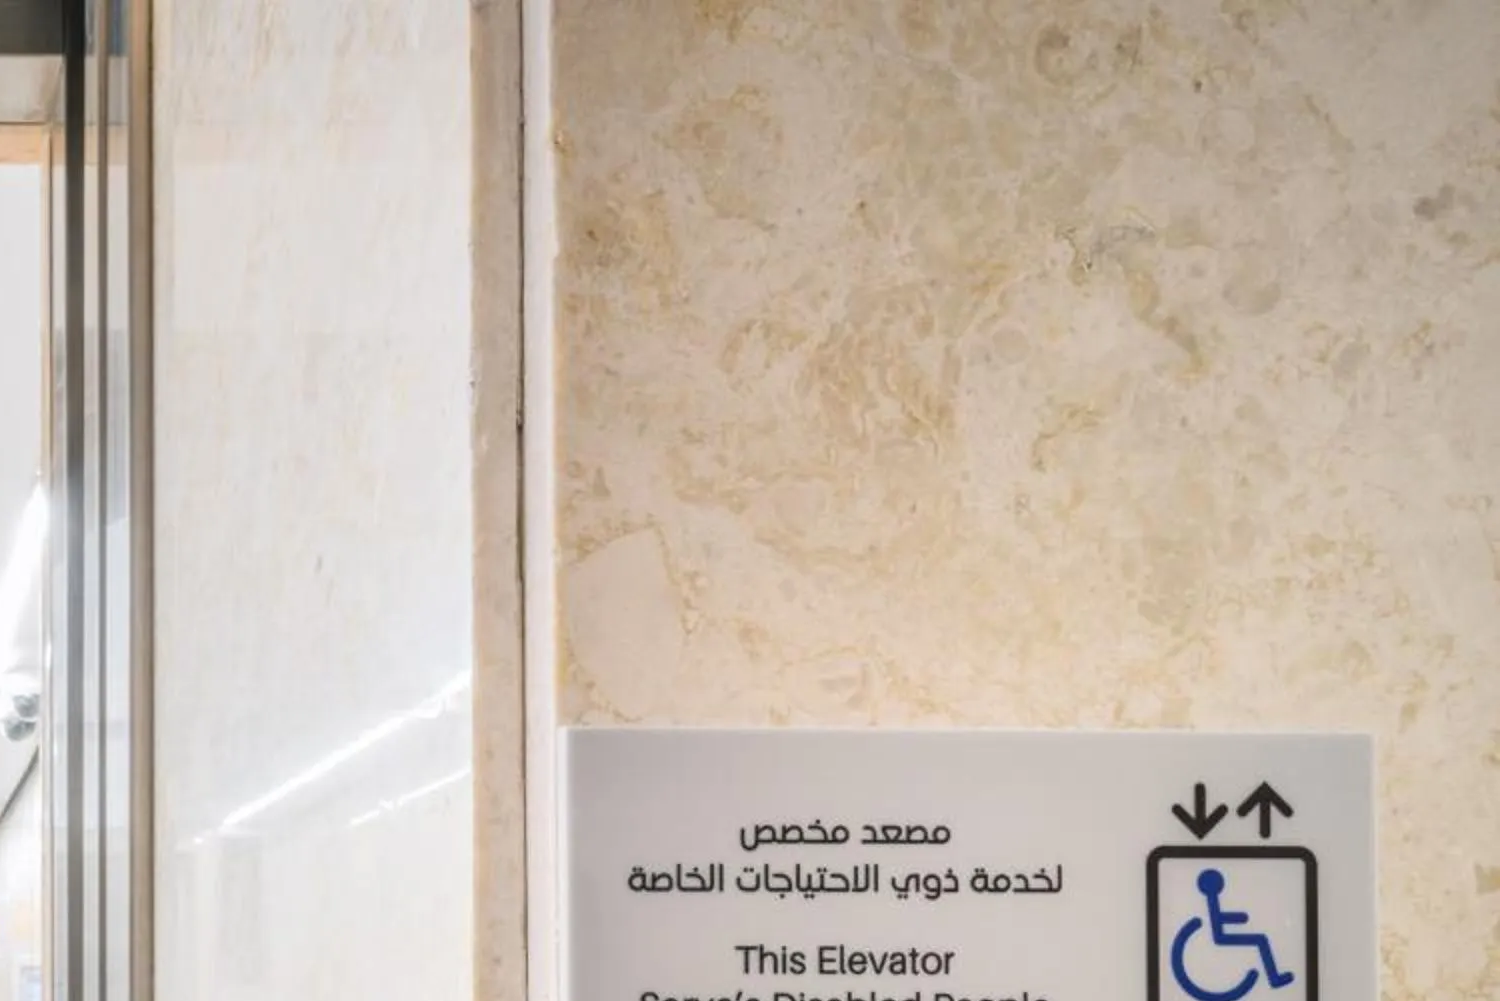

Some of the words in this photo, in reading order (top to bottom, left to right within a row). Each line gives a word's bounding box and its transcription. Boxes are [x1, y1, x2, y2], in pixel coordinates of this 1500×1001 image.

[739, 819, 850, 852] مخصص
[860, 823, 951, 846] مصعد
[627, 863, 725, 893] الخاصة
[735, 863, 879, 900] الاحتياجات
[890, 868, 960, 901] ذوي
[969, 864, 1063, 894] لخدمة
[734, 943, 807, 976] This
[817, 944, 955, 976] Elevator
